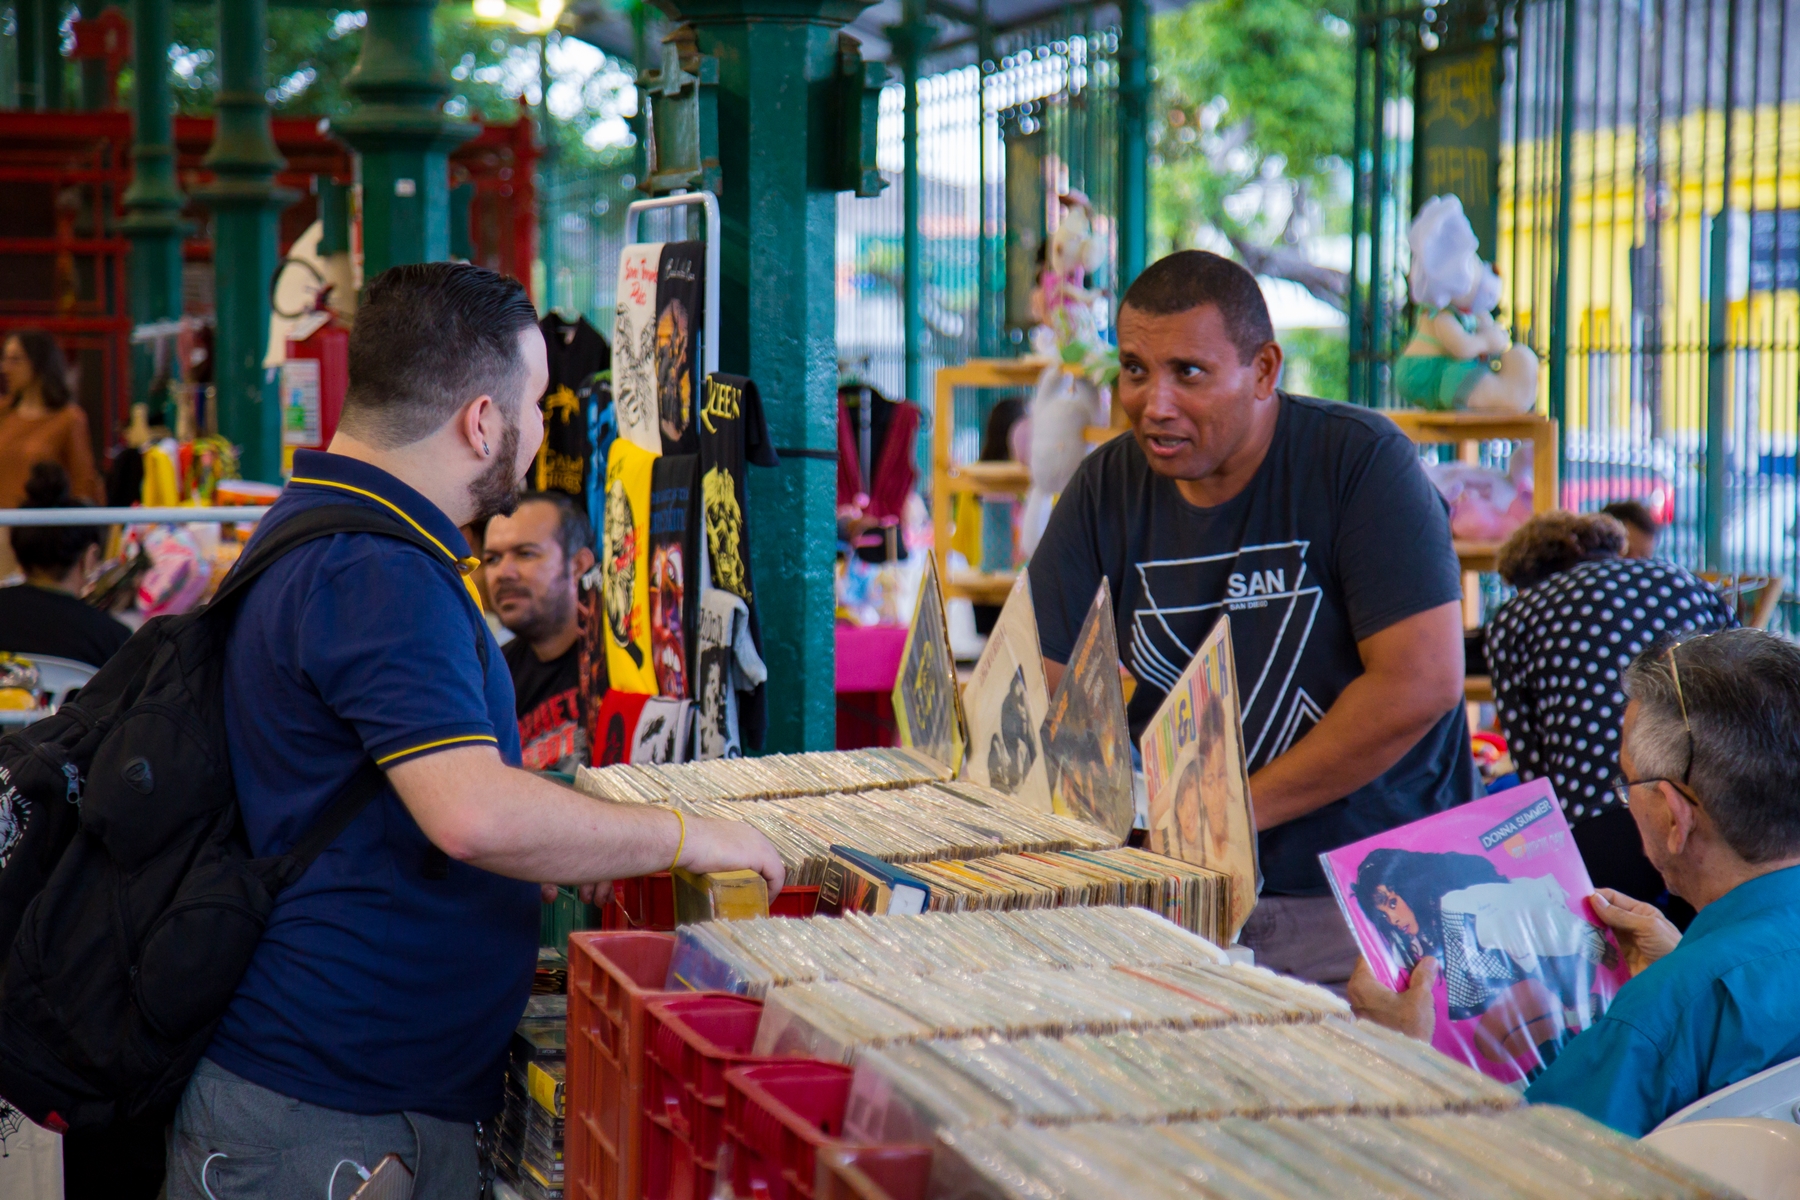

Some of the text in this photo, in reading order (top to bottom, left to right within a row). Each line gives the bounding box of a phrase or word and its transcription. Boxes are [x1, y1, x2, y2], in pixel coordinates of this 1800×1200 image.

[701, 375, 742, 434] QUEEN
[1227, 568, 1286, 598] SAN
[1229, 600, 1268, 611] SAN DIEGO
[1482, 822, 1518, 848] DONNA
[1515, 799, 1552, 827] SUMMER
